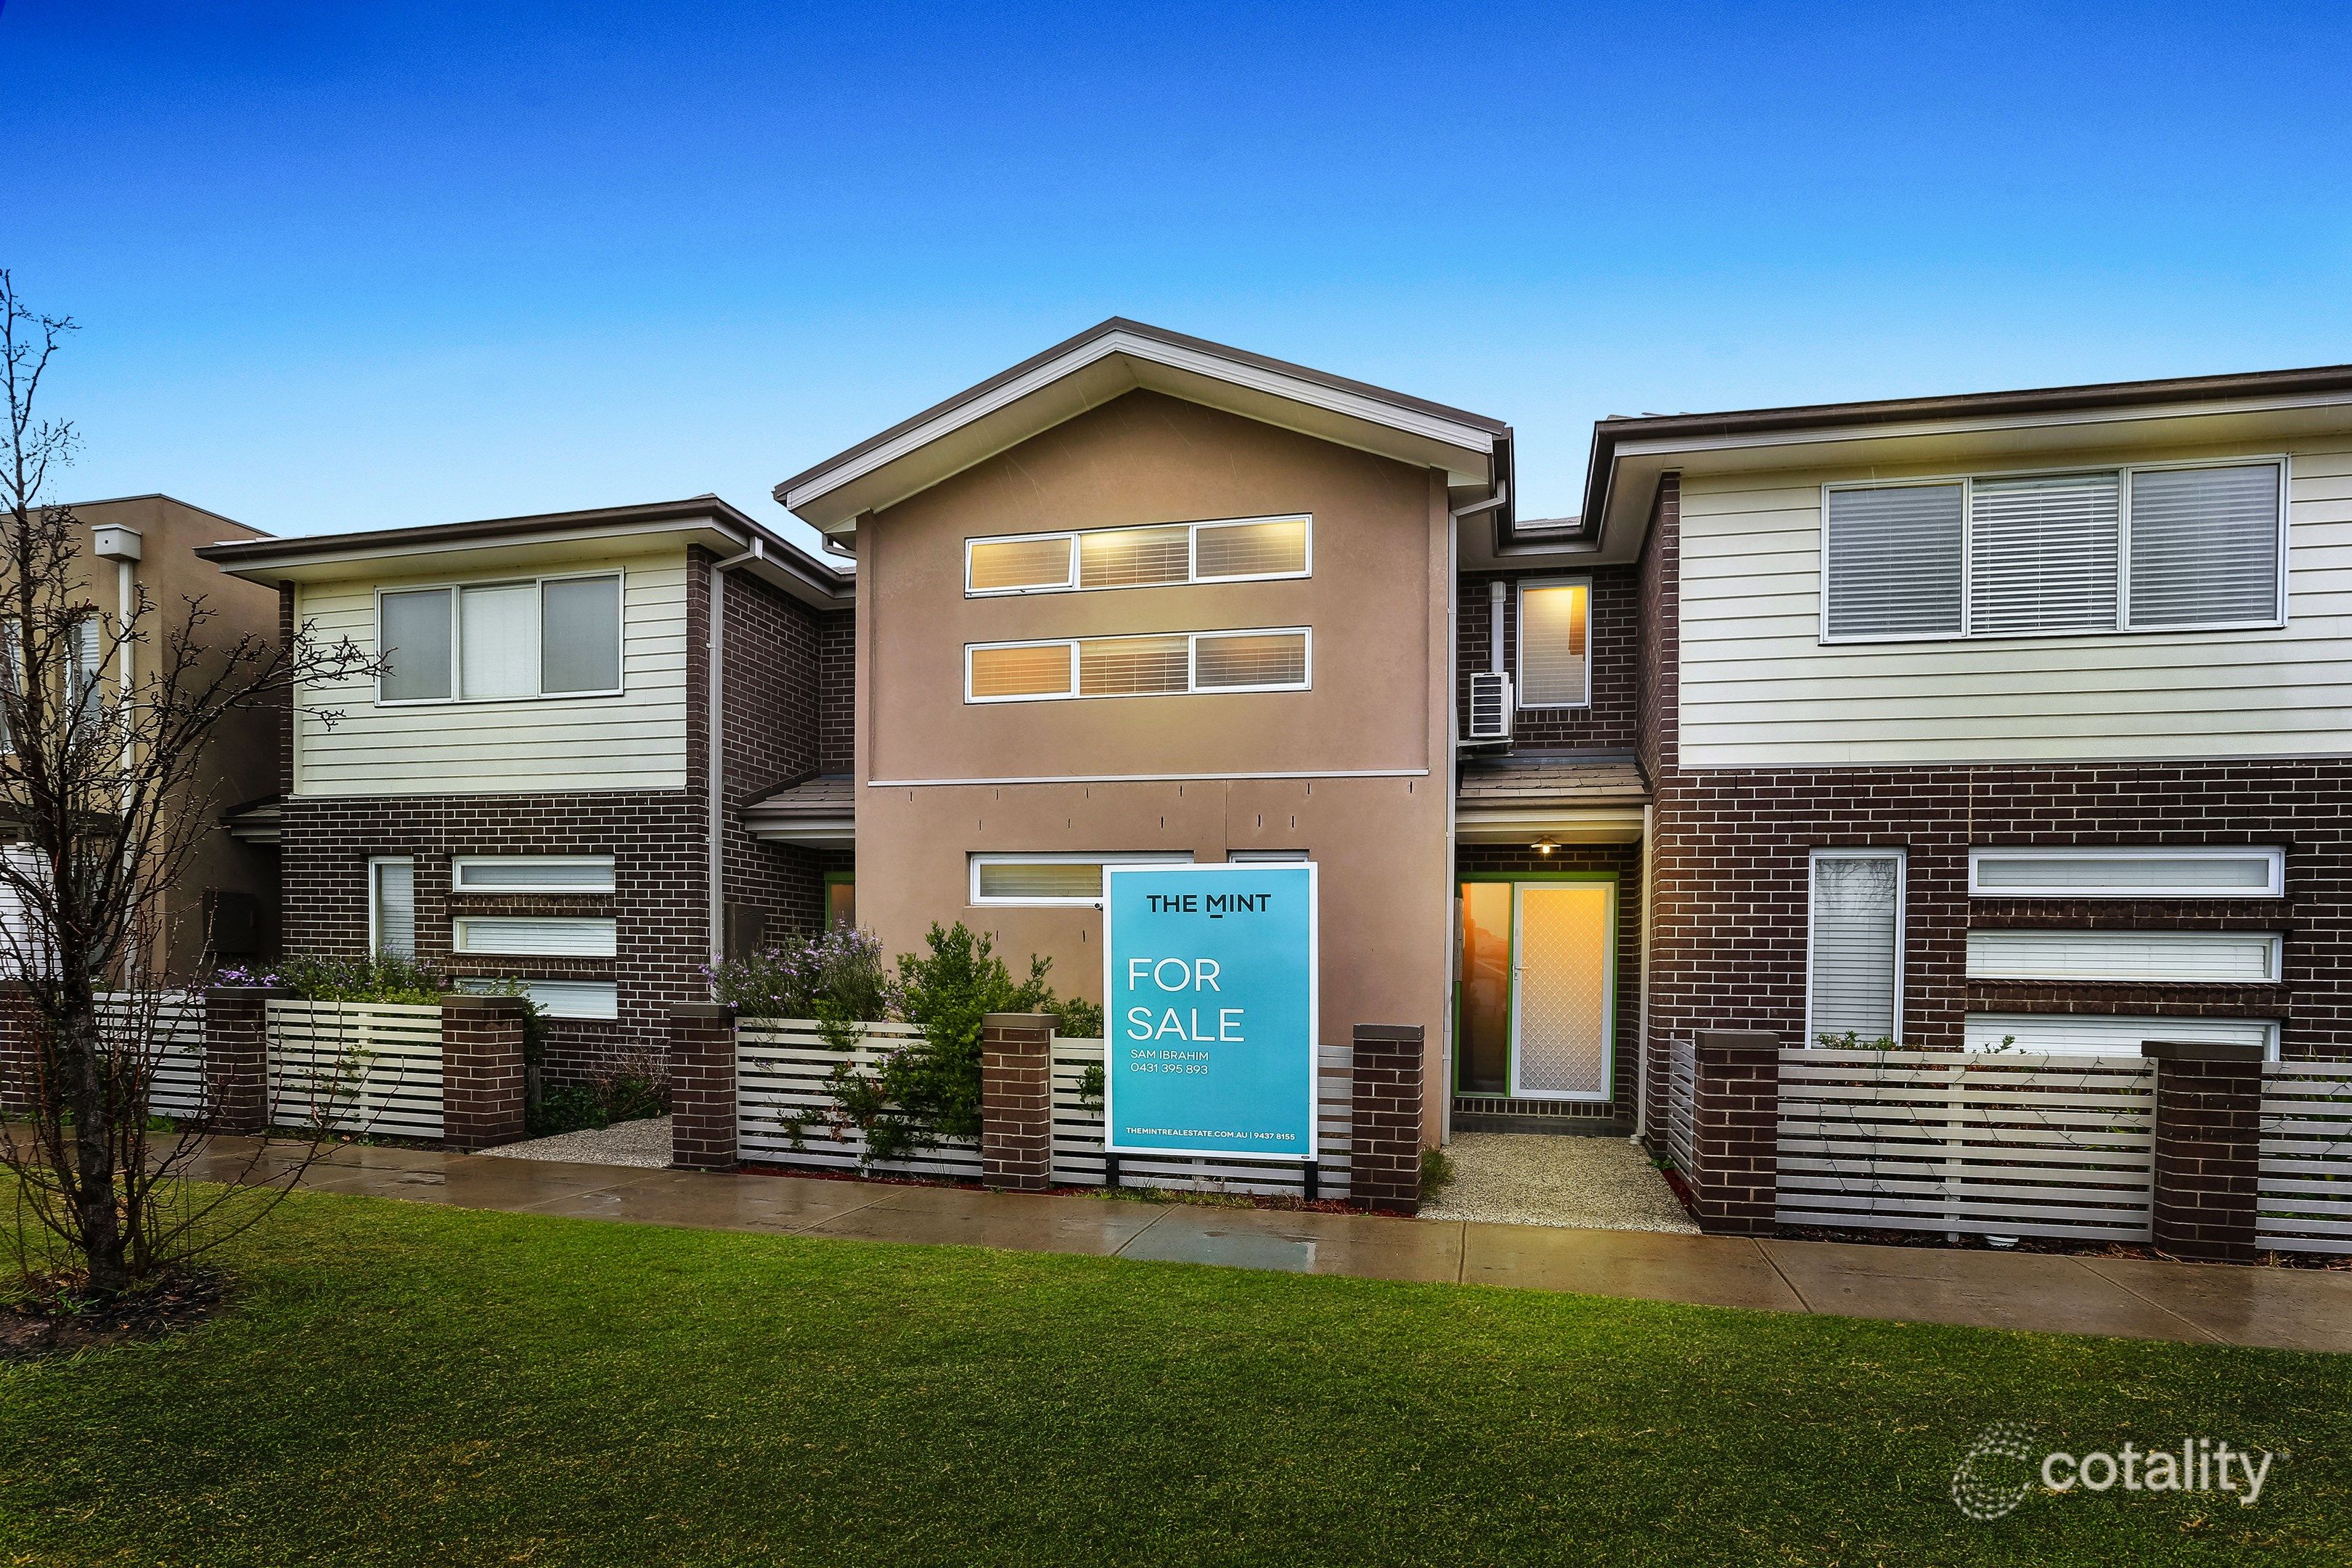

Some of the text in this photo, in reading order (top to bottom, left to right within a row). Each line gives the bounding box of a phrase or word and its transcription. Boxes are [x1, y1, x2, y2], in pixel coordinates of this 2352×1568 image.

[1146, 894, 1272, 912] THE MINT
[1128, 957, 1221, 992] FOR
[1127, 1006, 1245, 1042] SALE
[1130, 1049, 1209, 1061] SAM IBRAHIM
[1130, 1062, 1208, 1074] 0431 395 893
[1126, 1127, 1248, 1138] THEMINTREALESTATE.COM.AU
